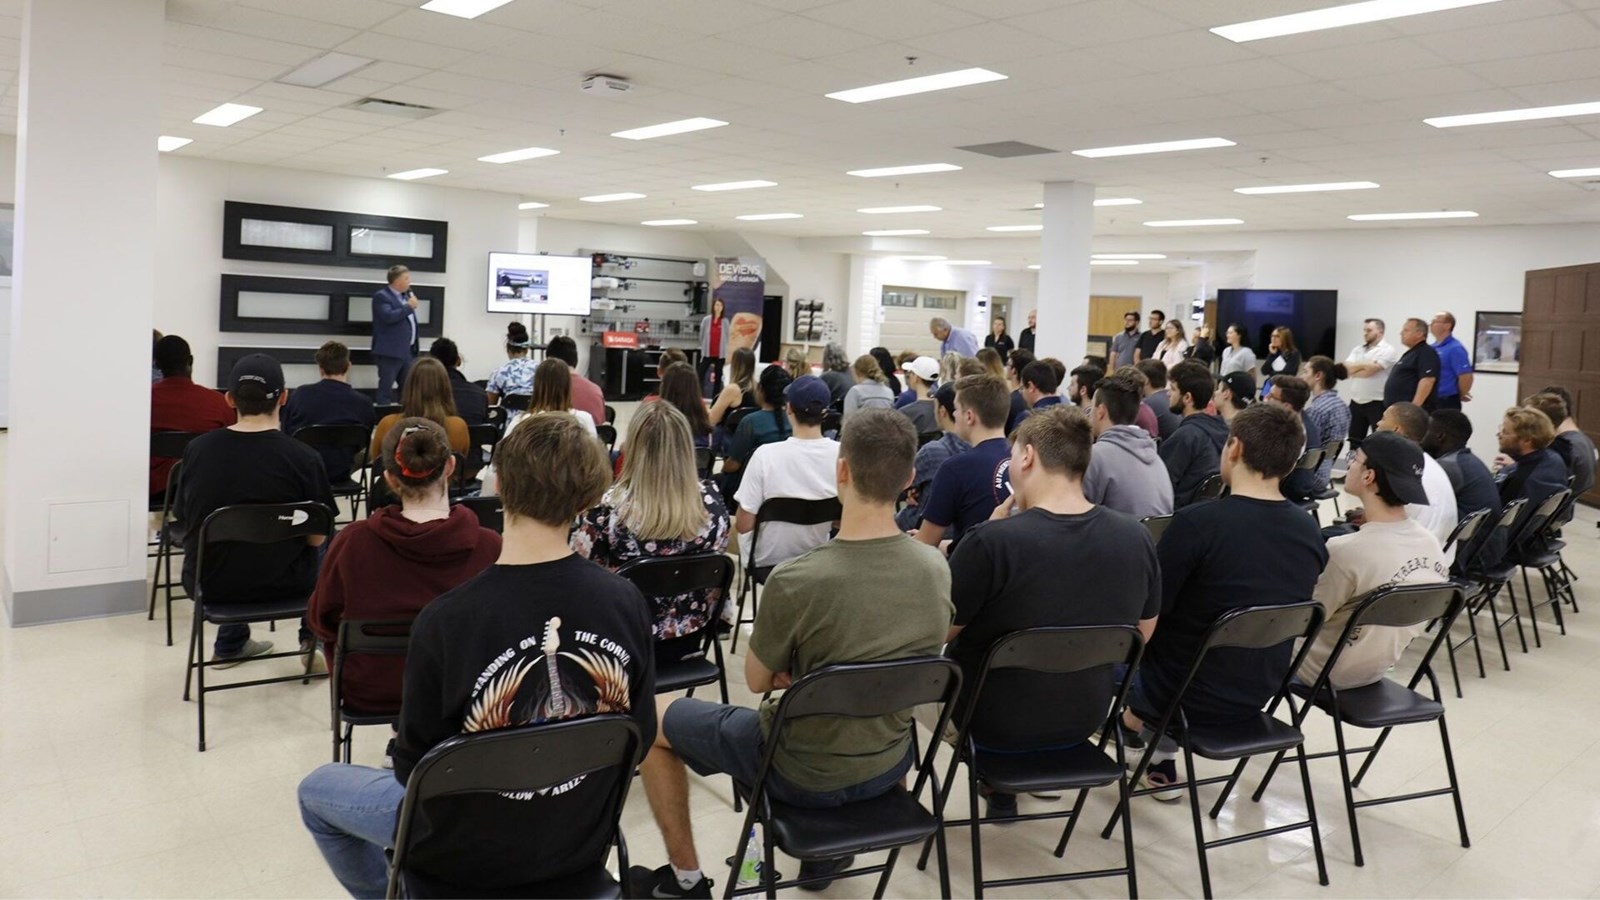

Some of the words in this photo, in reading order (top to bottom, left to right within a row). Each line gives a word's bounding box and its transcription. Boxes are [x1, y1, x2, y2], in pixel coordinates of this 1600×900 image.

[719, 263, 761, 275] DEVIENS
[519, 635, 538, 651] ON
[574, 630, 598, 645] THE
